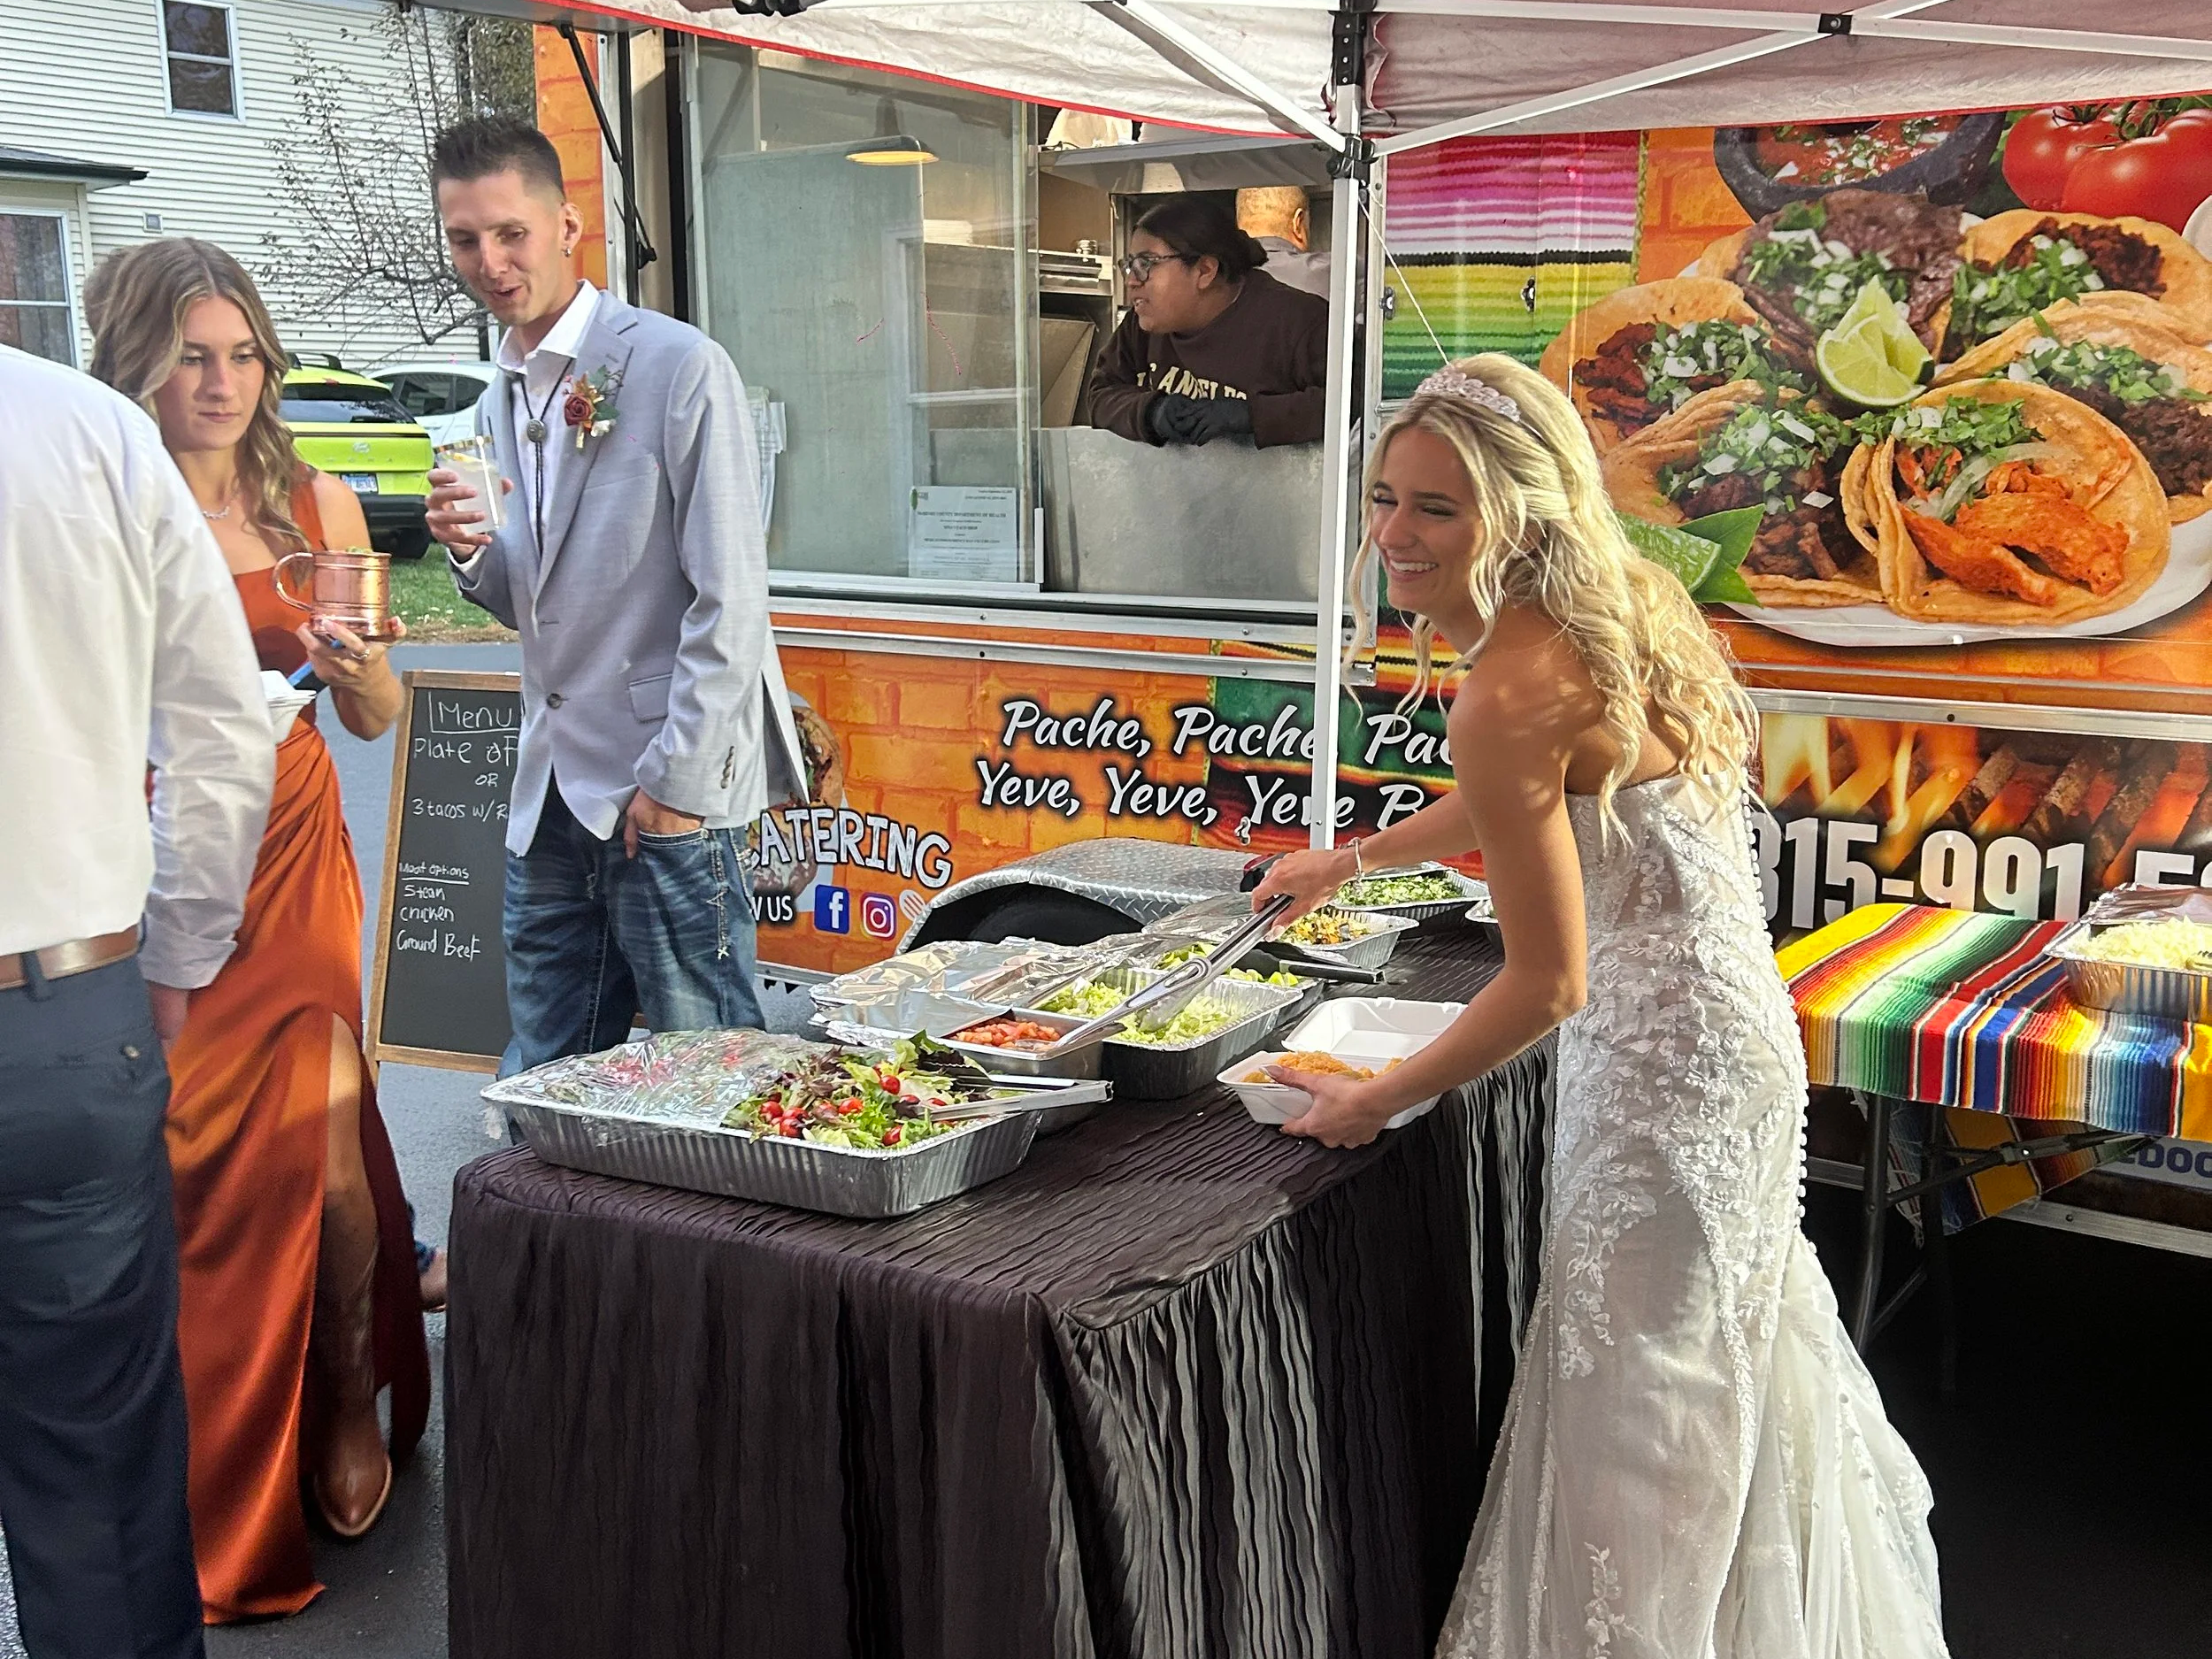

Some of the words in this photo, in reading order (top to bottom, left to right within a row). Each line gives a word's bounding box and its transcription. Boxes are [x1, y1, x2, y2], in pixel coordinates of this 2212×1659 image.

[439, 702, 512, 728] Menu
[1002, 698, 1151, 757] Pache,
[414, 737, 472, 764] Plate
[977, 760, 1080, 817] Yeve,
[1105, 767, 1217, 826] Yeve,
[412, 798, 424, 816] 3
[767, 895, 794, 922] US
